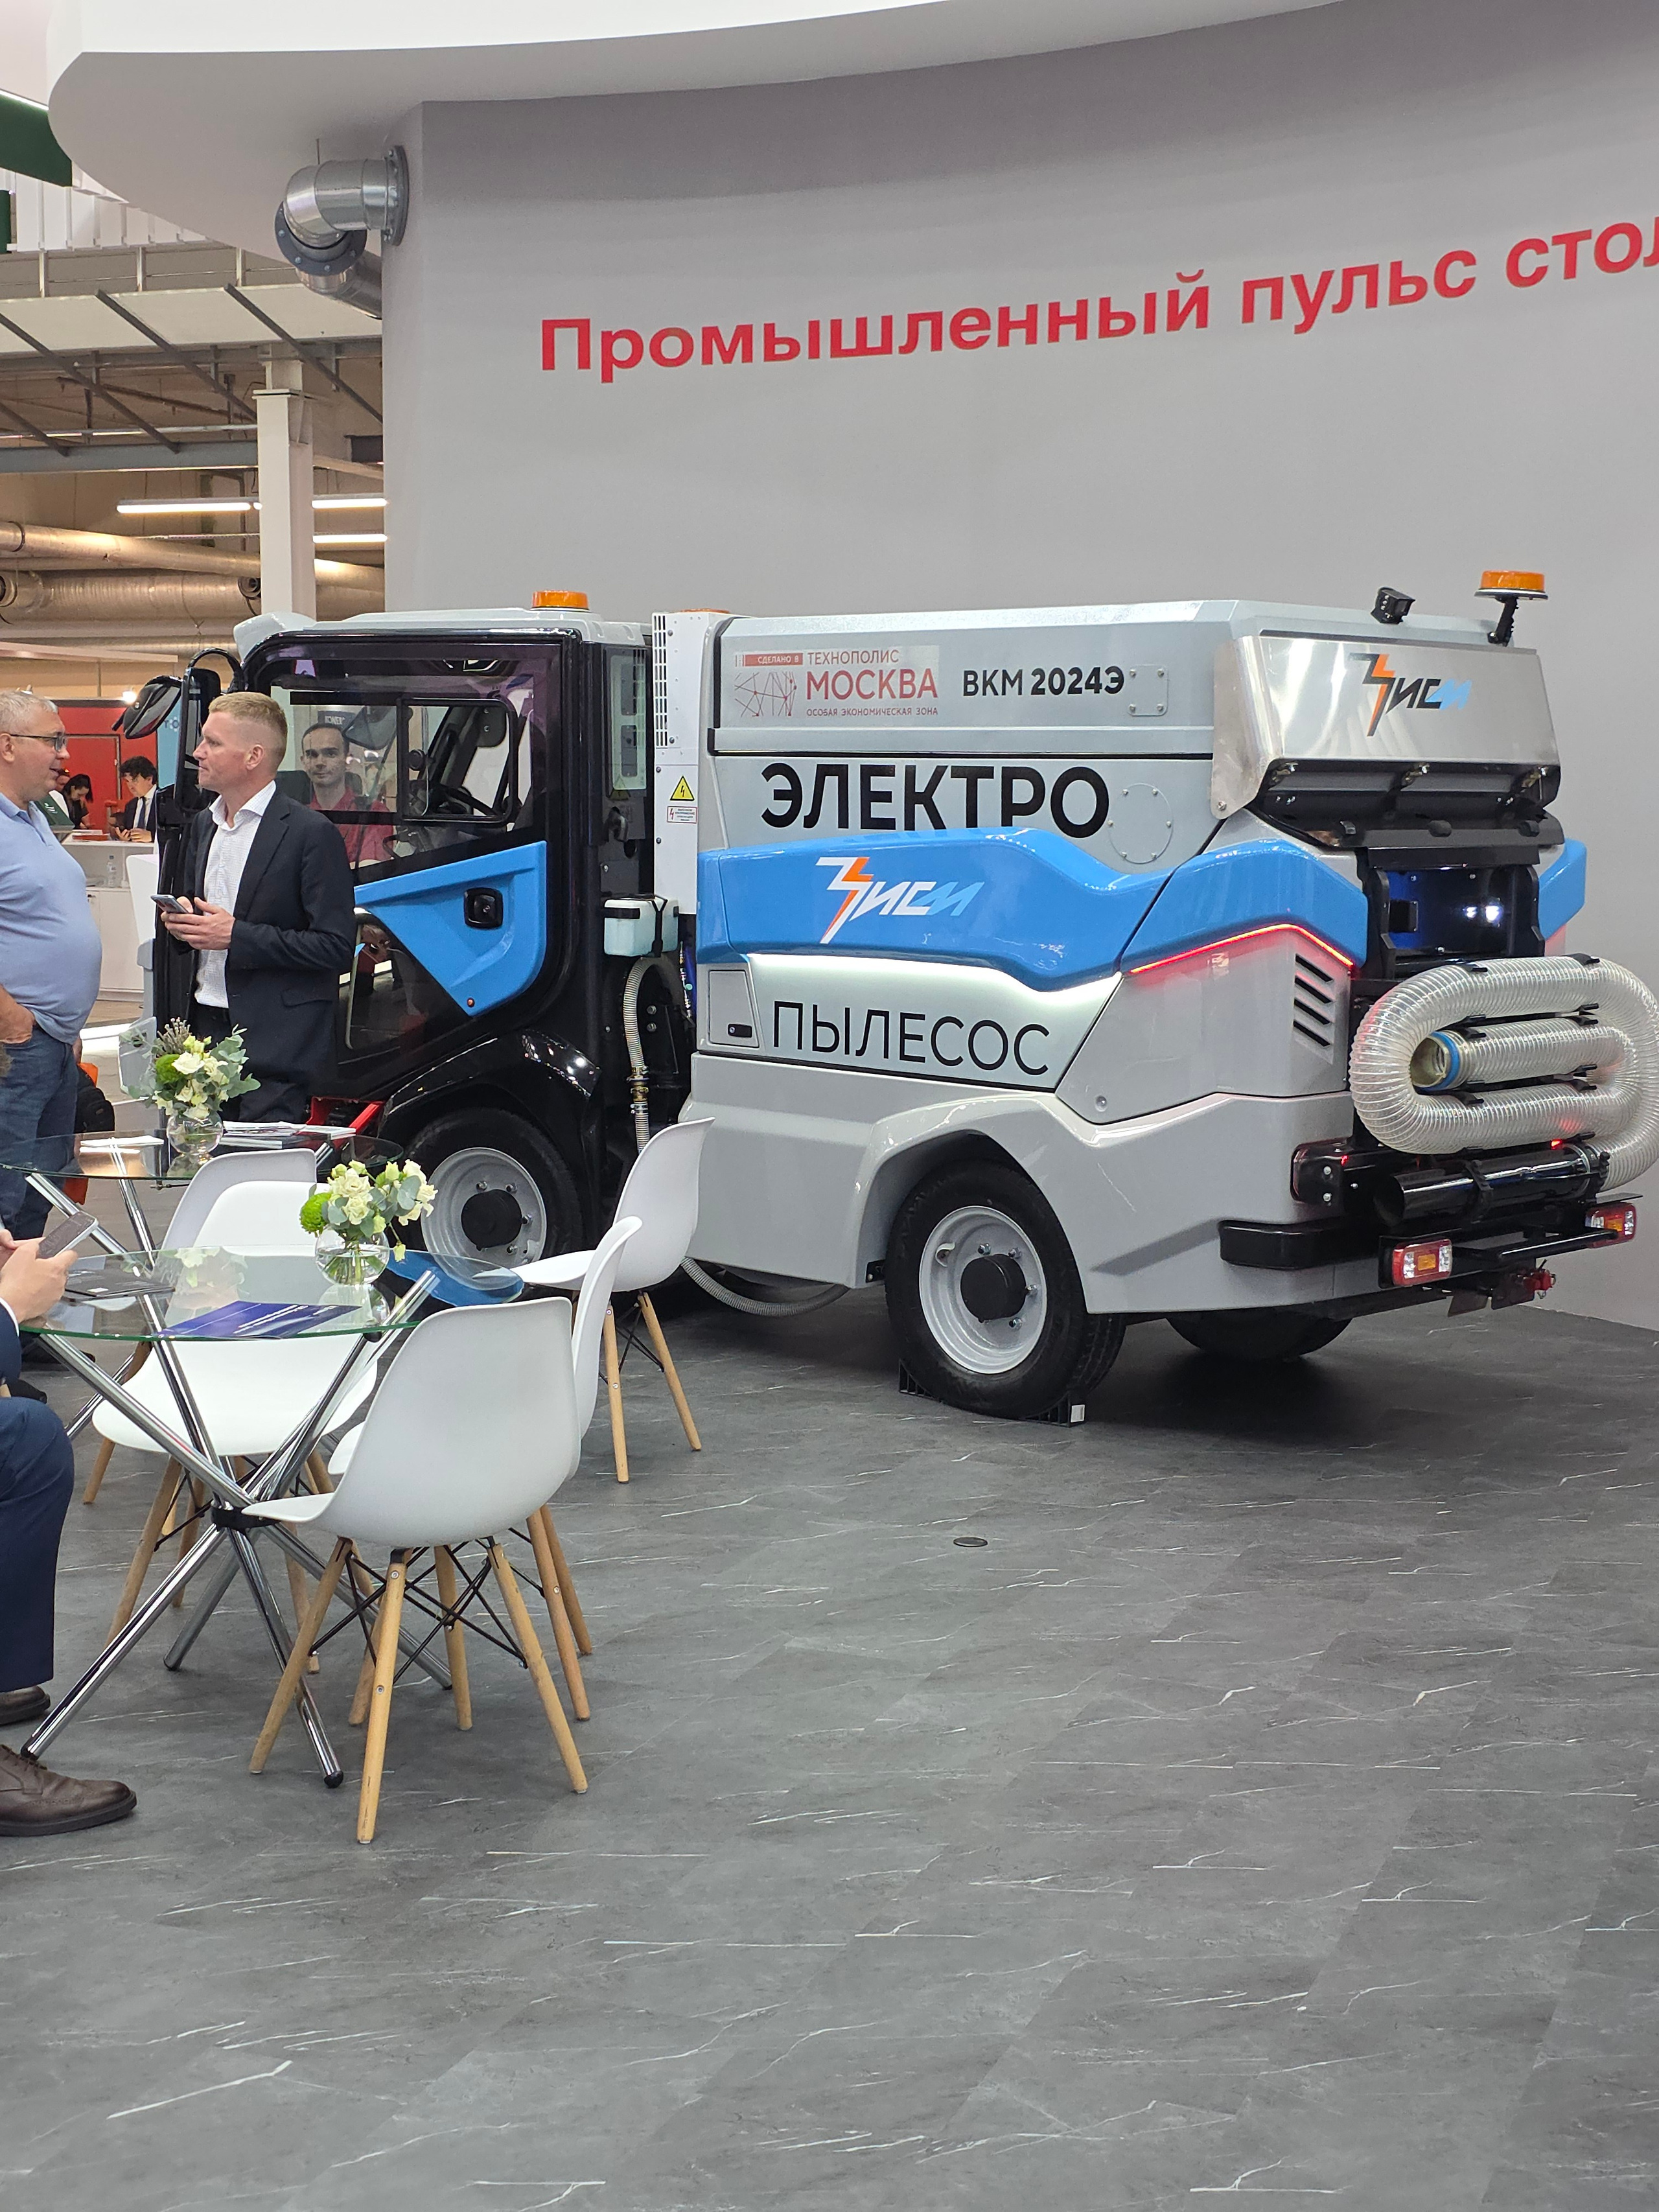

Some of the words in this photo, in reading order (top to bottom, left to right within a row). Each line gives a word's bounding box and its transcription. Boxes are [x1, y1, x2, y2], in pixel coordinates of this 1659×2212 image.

[541, 269, 1210, 384] Промышленный
[1242, 249, 1477, 334] пульс
[758, 655, 791, 664] СДЕЛАНО
[807, 650, 899, 666] ТЕХНОПОЛИС
[807, 668, 938, 700] МОСКВА
[963, 669, 1023, 696] ВКМ
[1030, 666, 1124, 695] 2024Э
[841, 708, 912, 716] ЭКОНОМИЧЕСКАЯ
[761, 762, 1109, 839] ЭЛЕКТРО
[773, 1000, 1050, 1076] ПЫЛЕСОС
